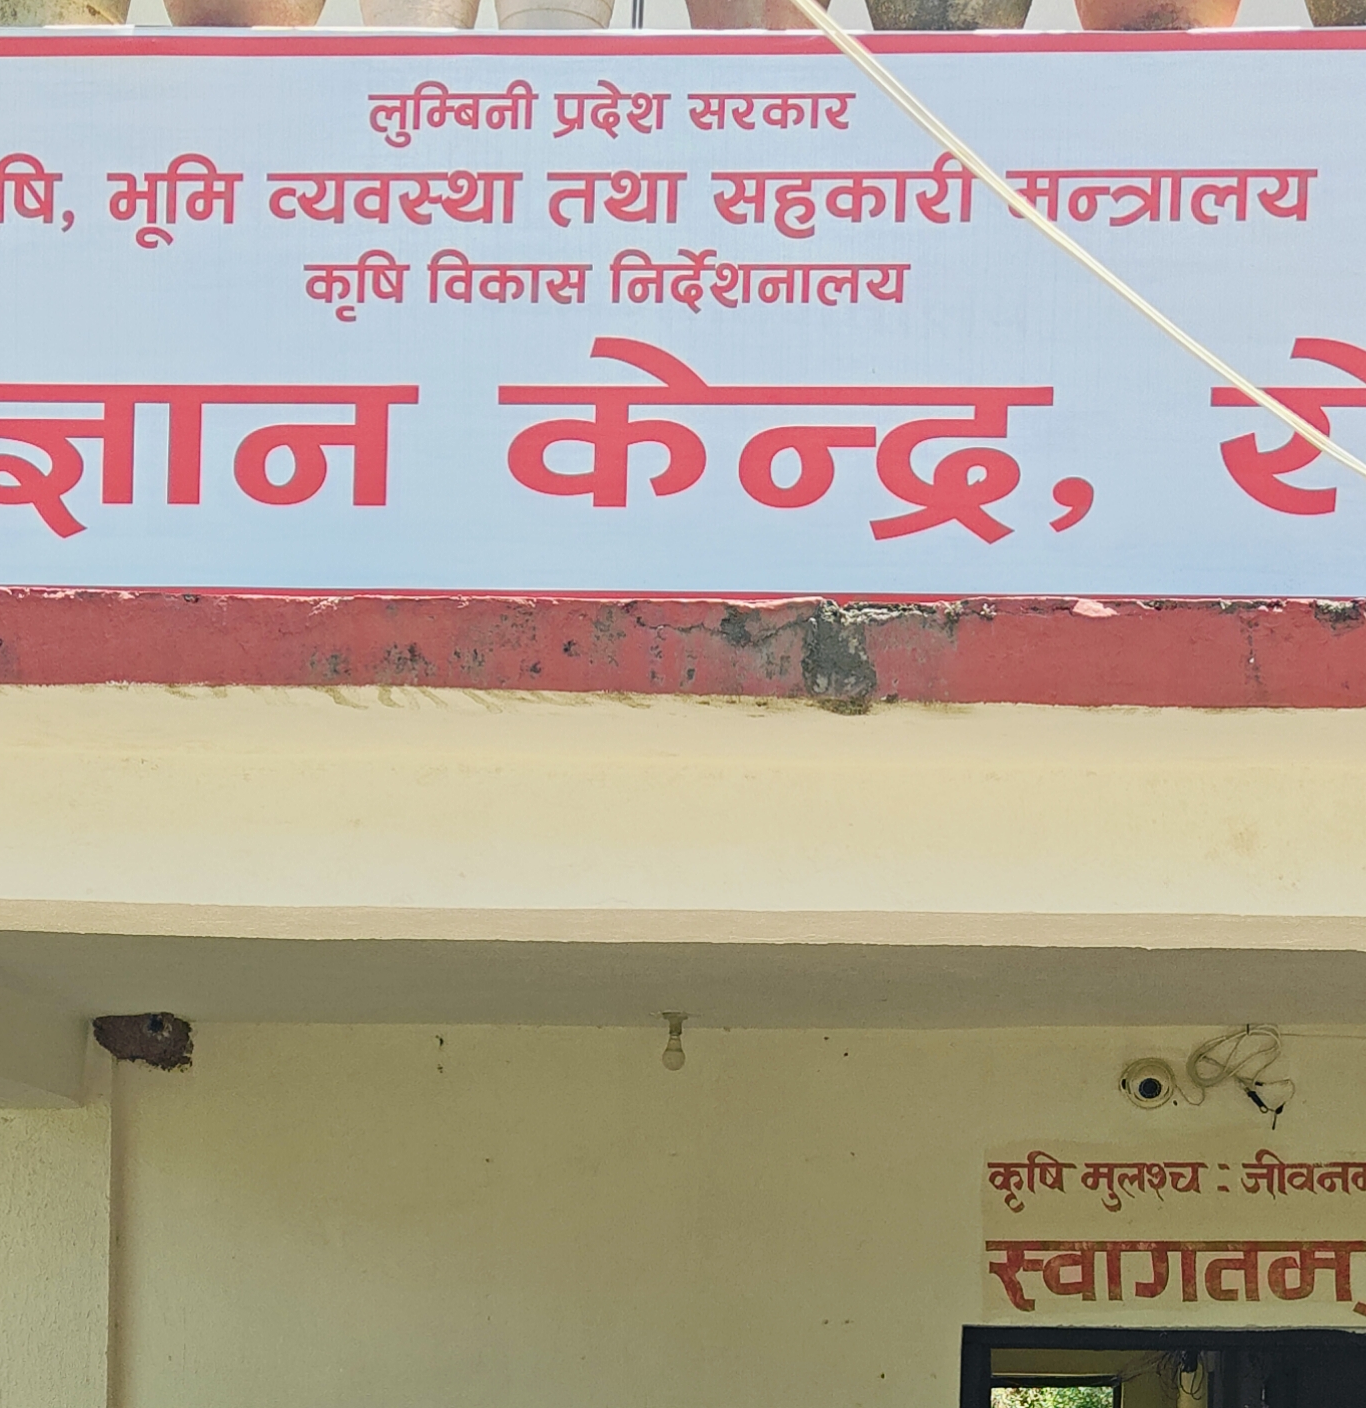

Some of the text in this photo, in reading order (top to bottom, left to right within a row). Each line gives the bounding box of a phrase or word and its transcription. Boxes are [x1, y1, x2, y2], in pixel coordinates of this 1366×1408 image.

[368, 80, 856, 148] लुम्बिनी प्रदेश सरकार
[107, 153, 244, 249] भूमि
[268, 168, 524, 227] व्यवस्था
[547, 169, 688, 228] तथा
[711, 151, 981, 240] सहकारी
[1005, 168, 1319, 228] मन्त्रालय
[306, 248, 912, 322] कृषि विकास निर्देशनालय
[497, 337, 1095, 545] केन्द्र,
[987, 1149, 1077, 1214] कृषि
